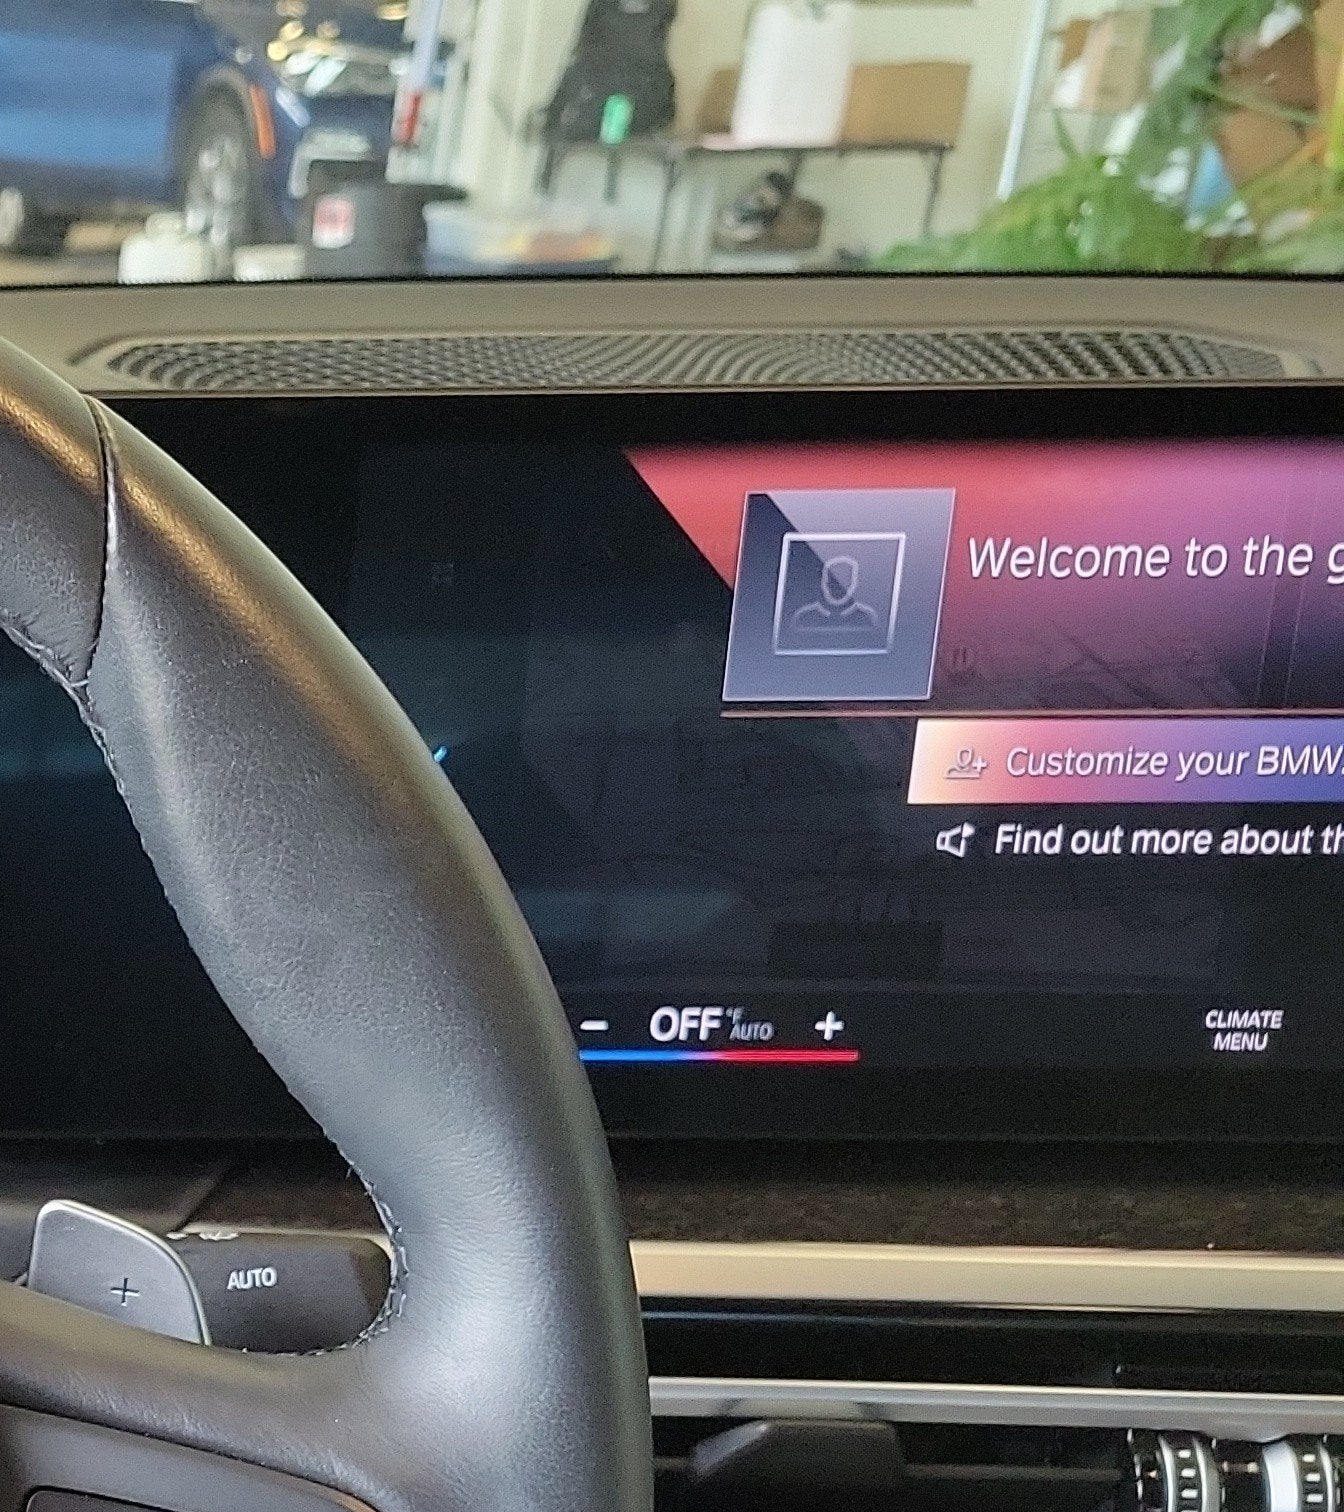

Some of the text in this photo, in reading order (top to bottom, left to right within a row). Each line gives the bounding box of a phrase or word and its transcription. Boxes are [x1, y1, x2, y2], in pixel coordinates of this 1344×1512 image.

[968, 537, 1171, 578] Welcome
[1185, 537, 1229, 577] to
[1242, 534, 1313, 577] the
[1006, 745, 1169, 777] Customize
[1174, 750, 1251, 781] your
[995, 823, 1064, 855] Find
[1070, 825, 1122, 855] out
[1130, 828, 1211, 855] more
[1220, 823, 1314, 855] about
[649, 1005, 723, 1042] OFF
[729, 1021, 775, 1041] AUTO
[1205, 1009, 1285, 1029] CLIMATE
[1213, 1032, 1270, 1051] MENU
[226, 1266, 279, 1291] AUTO
